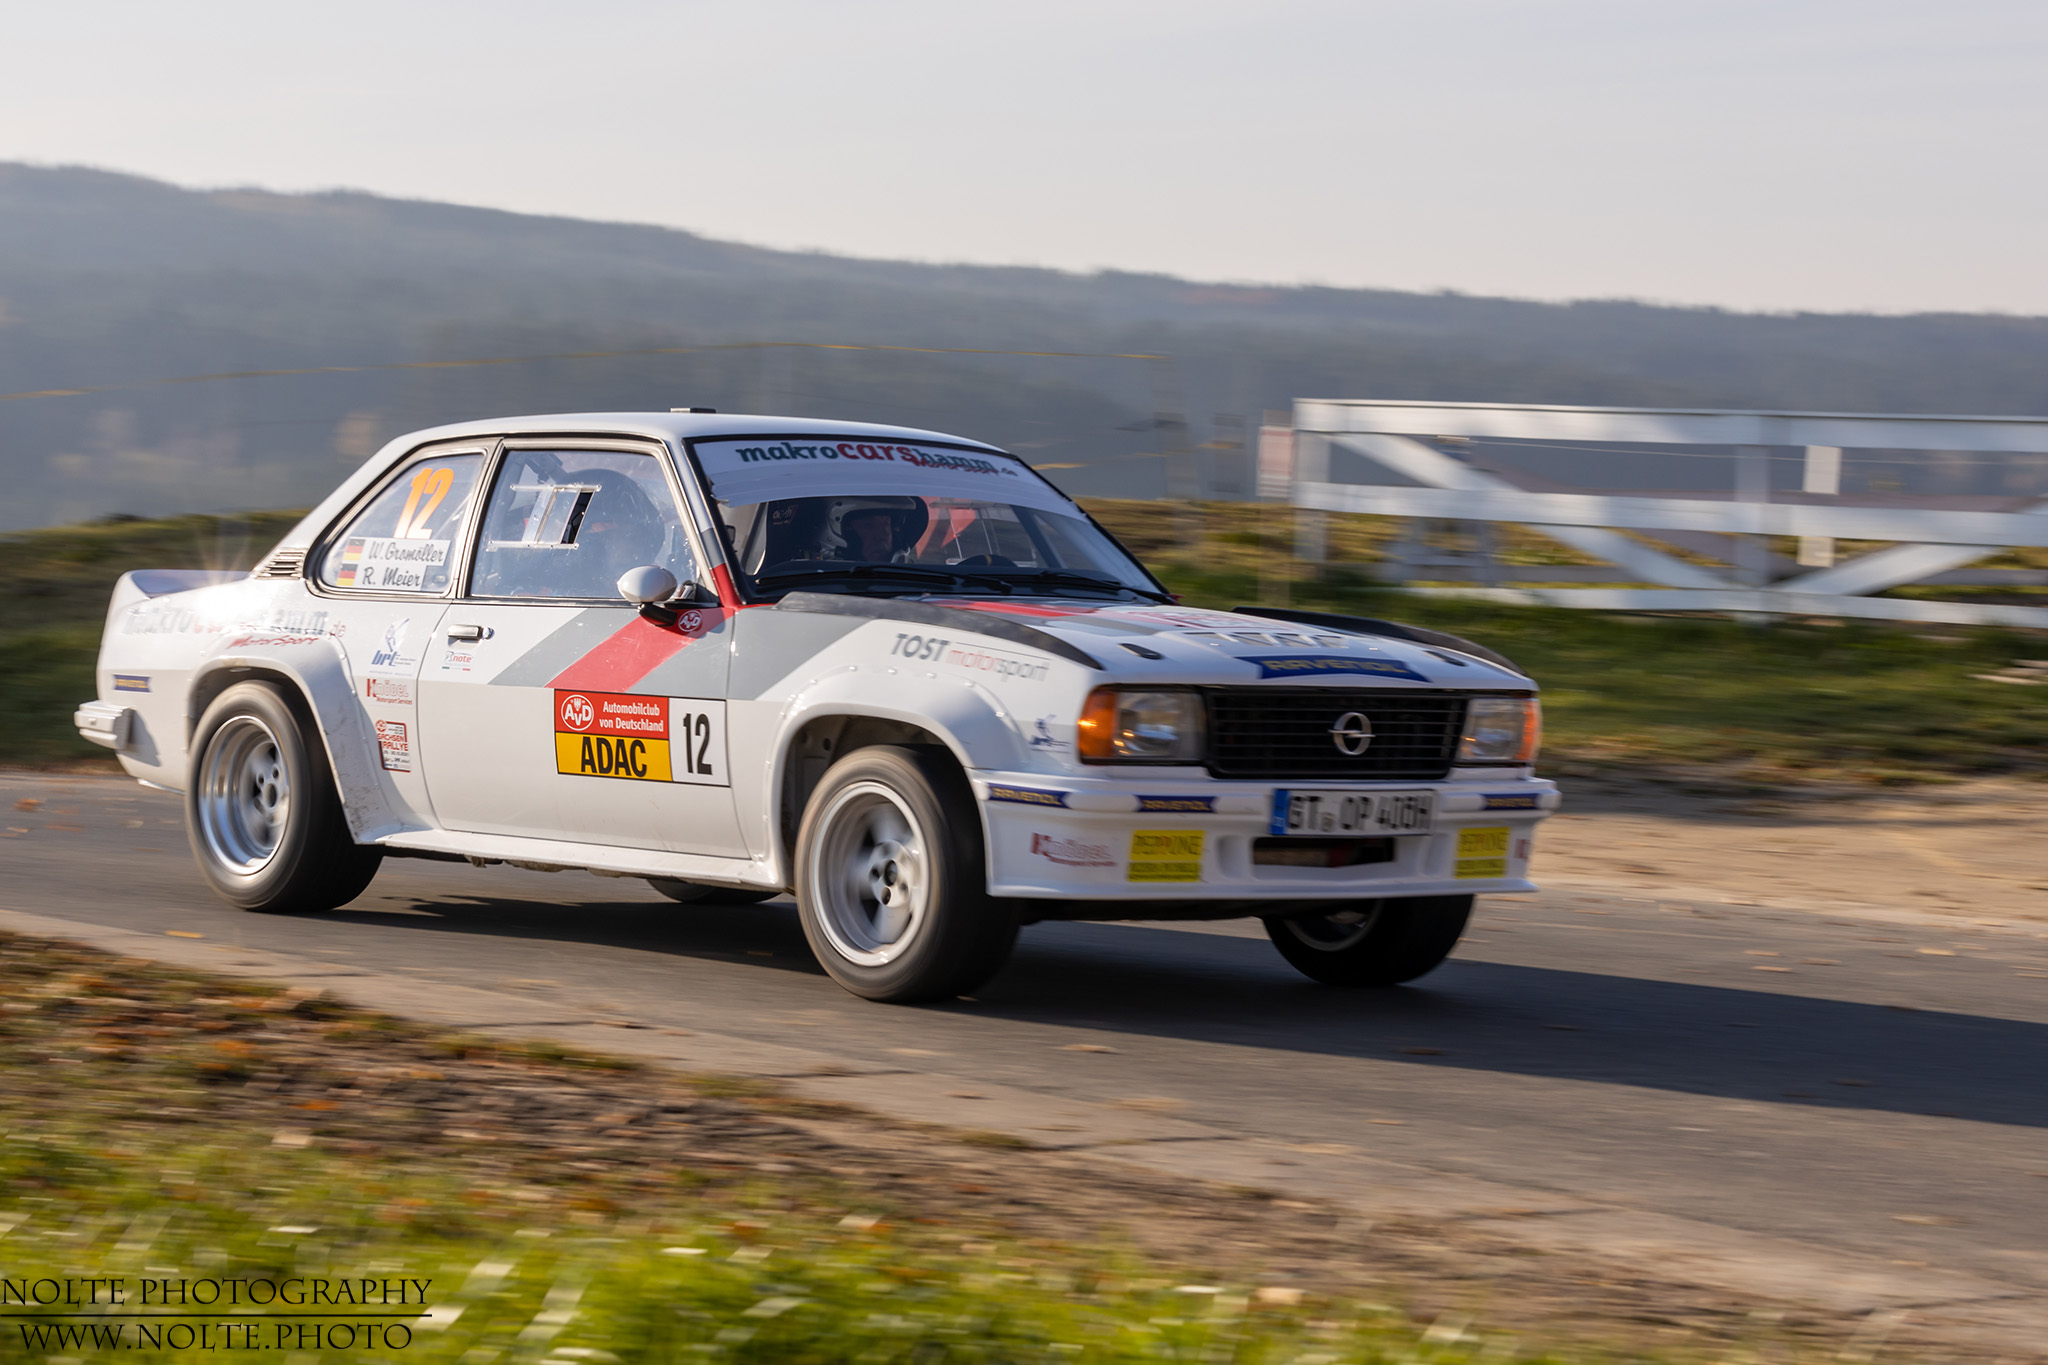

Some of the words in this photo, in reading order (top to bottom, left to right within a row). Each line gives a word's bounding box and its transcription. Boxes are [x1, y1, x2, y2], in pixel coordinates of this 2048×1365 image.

[394, 468, 454, 539] 12
[363, 567, 376, 585] R.
[383, 567, 420, 586] Meier
[890, 633, 951, 662] TOST
[603, 701, 660, 717] Automobilclub
[599, 719, 614, 729] von
[615, 717, 664, 732] Deutschland
[382, 741, 408, 751] RALLYE
[683, 713, 713, 776] 12
[581, 736, 647, 778] ADAC
